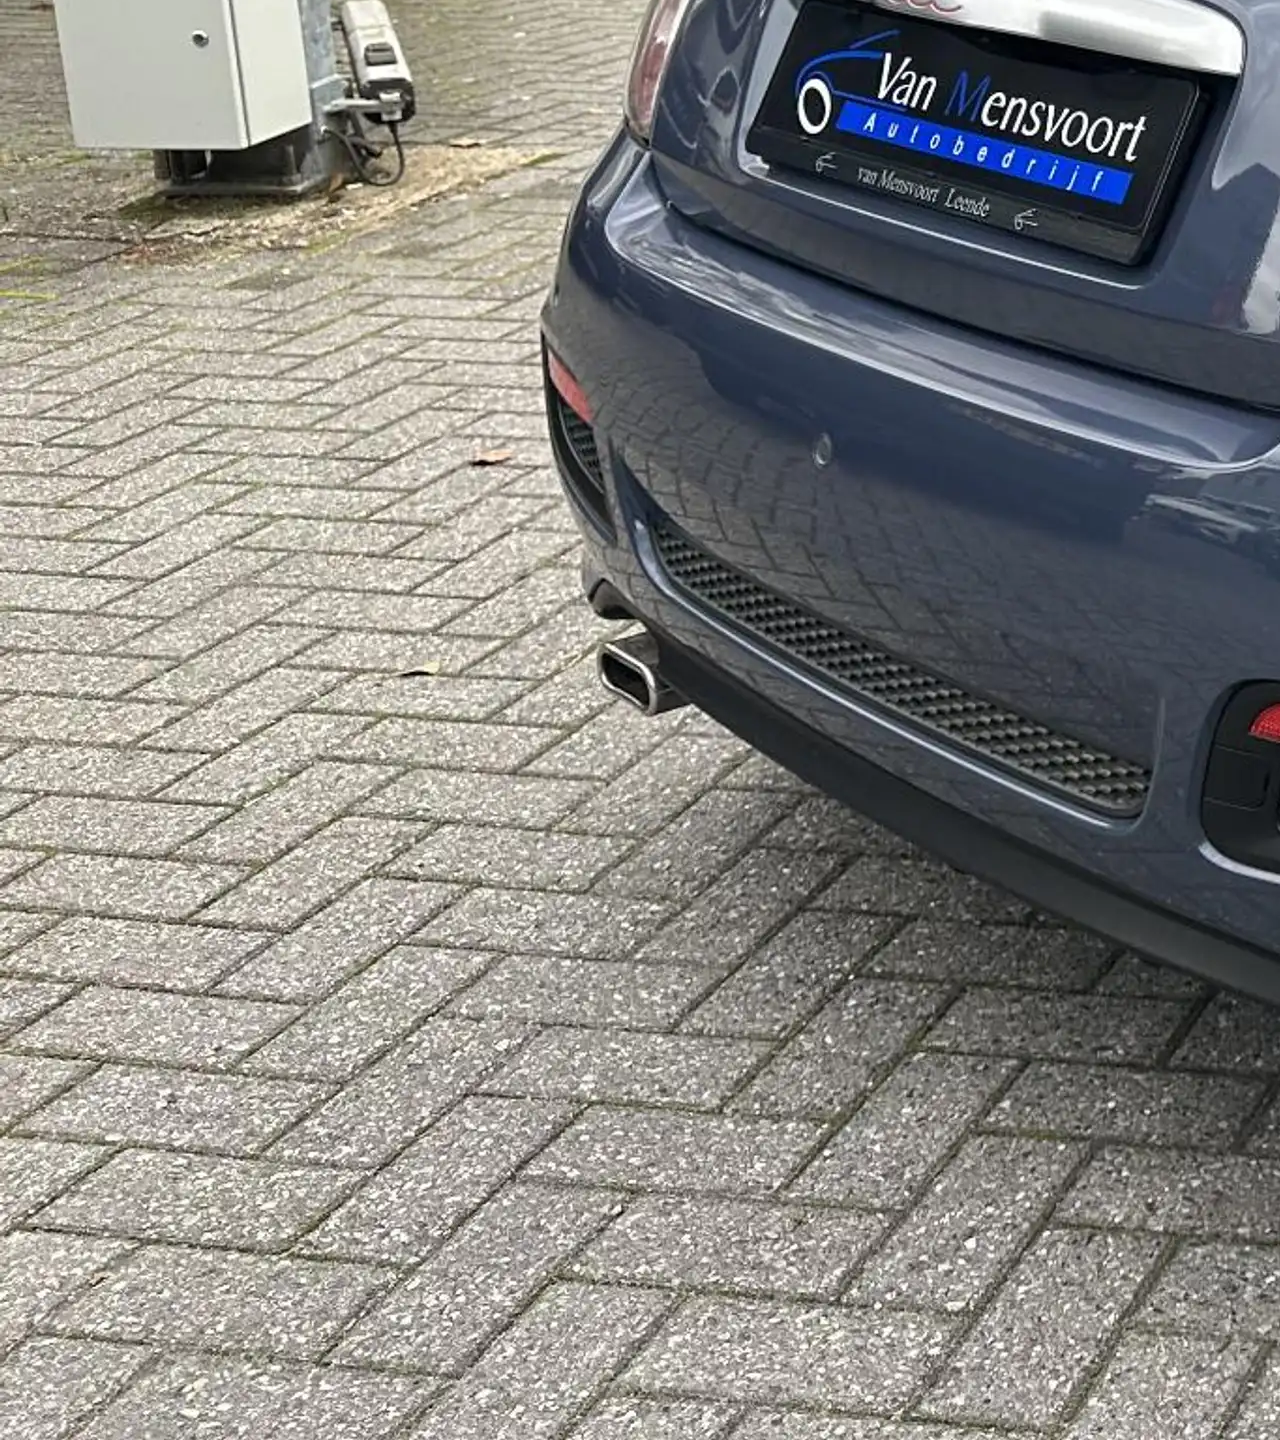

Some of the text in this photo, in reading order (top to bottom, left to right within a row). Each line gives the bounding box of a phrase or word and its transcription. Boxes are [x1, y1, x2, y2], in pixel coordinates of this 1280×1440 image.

[877, 52, 1146, 161] Van Mensvoort
[857, 167, 991, 217] van Mensvoort Leende
[863, 112, 1104, 192] Autobedrijf
